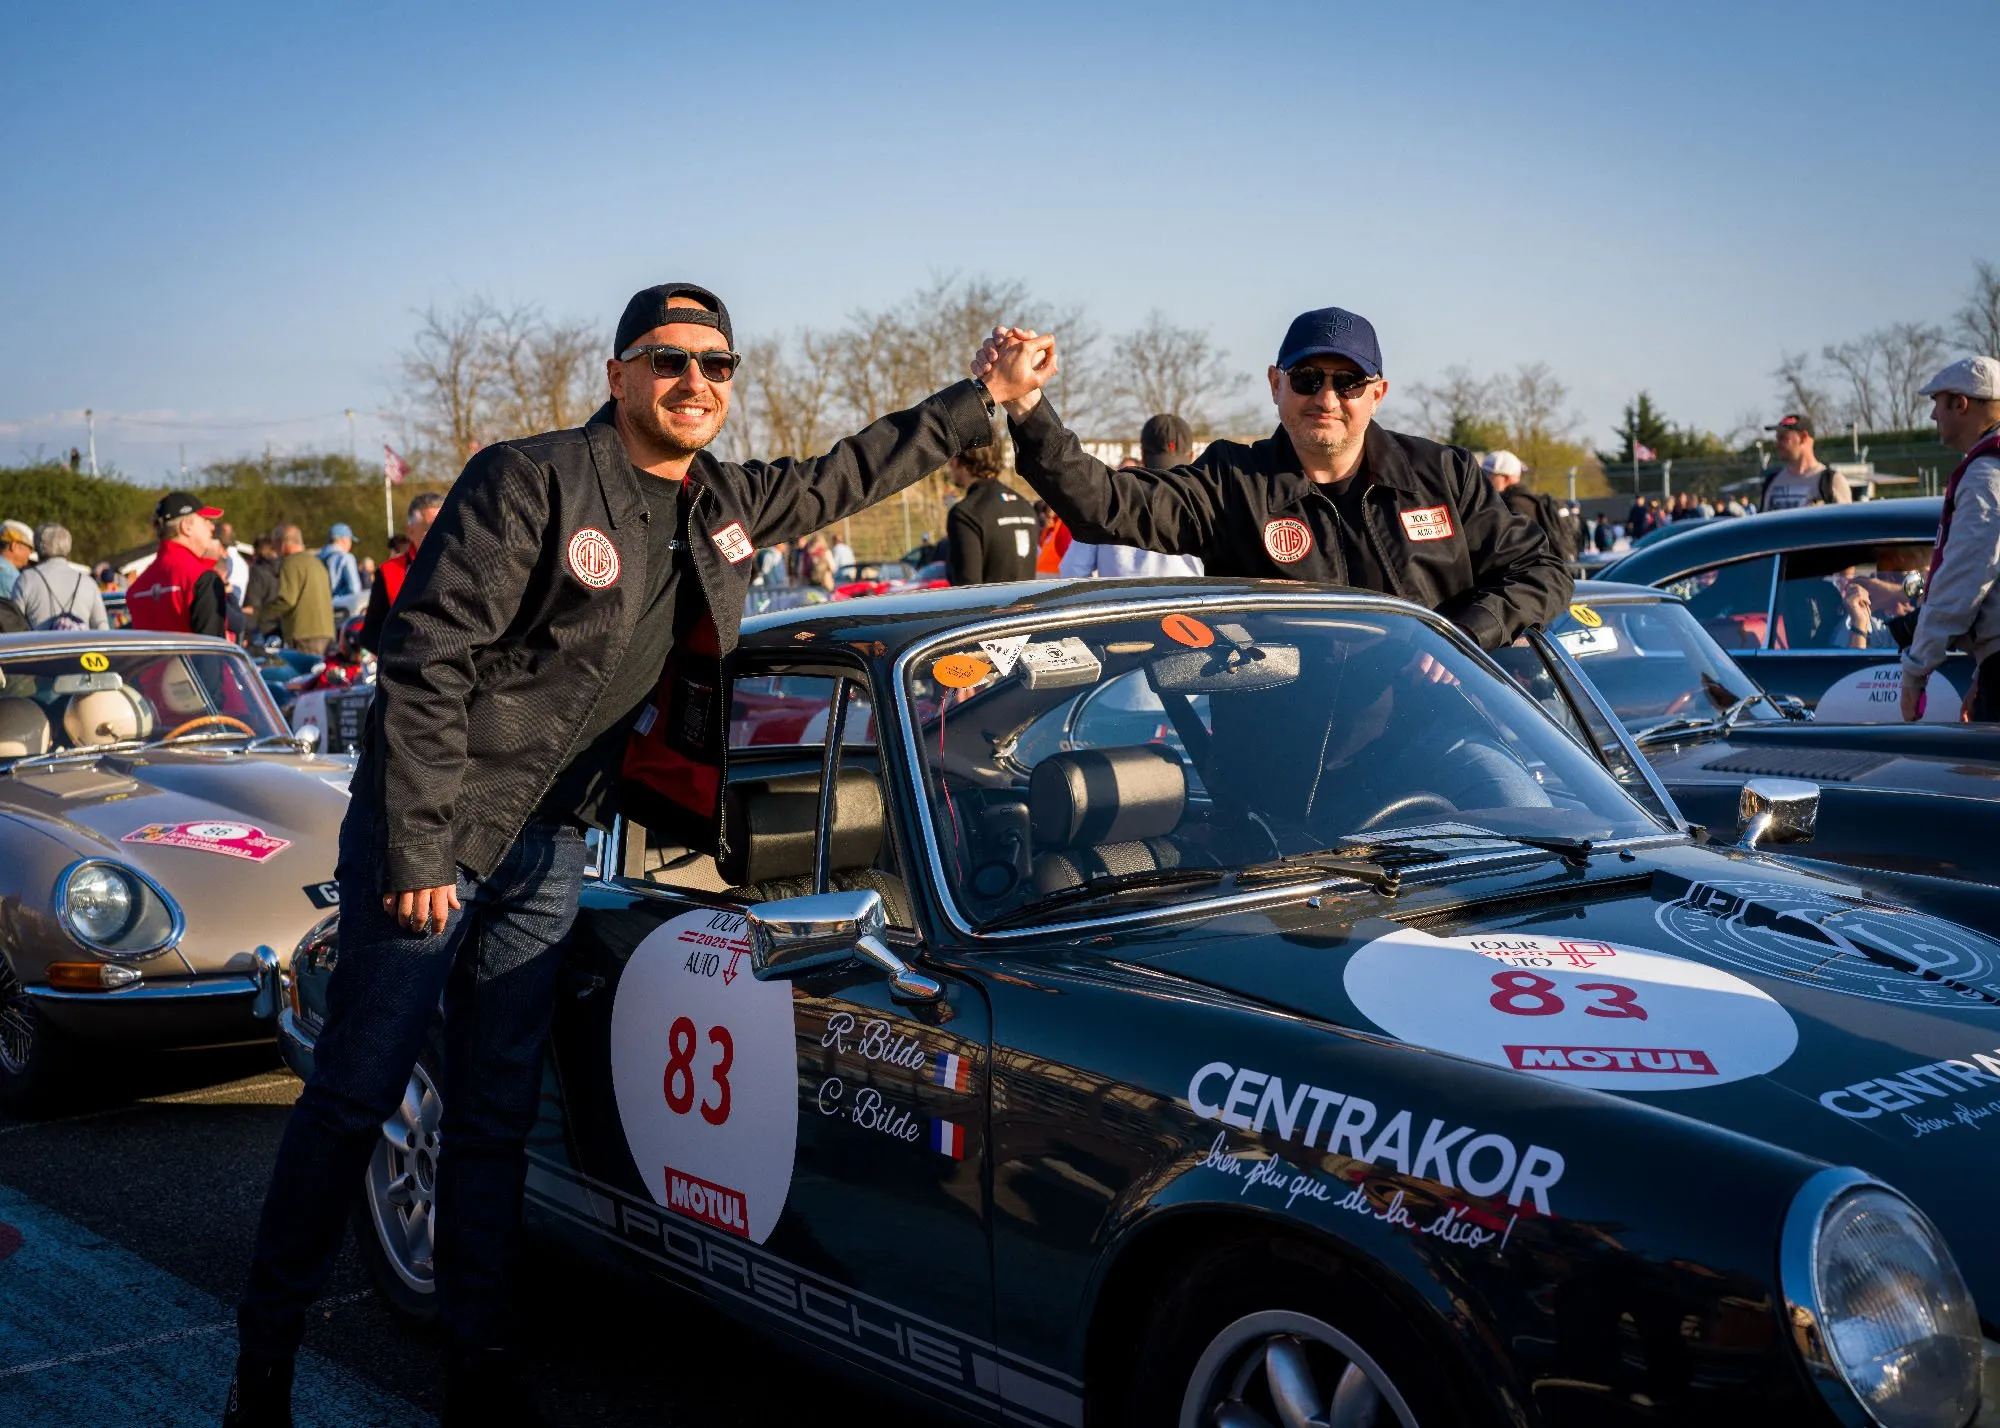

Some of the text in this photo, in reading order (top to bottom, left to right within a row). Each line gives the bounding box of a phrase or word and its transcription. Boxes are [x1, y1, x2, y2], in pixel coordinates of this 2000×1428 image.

[1285, 521, 1303, 530] AUTO
[576, 531, 611, 550] TOUR AUTO
[1272, 528, 1300, 553] DEUS
[580, 541, 609, 574] DEUS
[581, 574, 607, 586] FRANCE
[85, 656, 105, 668] M
[1873, 670, 1903, 681] TOUR
[1869, 690, 1898, 703] AUTO
[318, 882, 340, 904] G
[706, 912, 747, 934] TOUR
[695, 933, 730, 949] 2025
[684, 950, 720, 978] AUTO
[1497, 957, 1553, 967] UTO
[1489, 970, 1649, 1022] 83
[821, 1012, 926, 1071] R. Bilde
[663, 1016, 734, 1126] 83
[1521, 1048, 1705, 1071] MOTUL
[818, 1077, 920, 1142] C. Bilde
[1900, 1111, 1956, 1138] bien
[1187, 1061, 1565, 1217] CENTRAKOR
[1195, 1129, 1242, 1176] bien
[1240, 1153, 1289, 1196] plus
[1289, 1175, 1331, 1209] que
[1333, 1182, 1372, 1215] de
[1374, 1190, 1416, 1228] la
[1420, 1206, 1497, 1249] déco
[671, 1174, 745, 1230] MOTUL
[622, 1204, 964, 1381] PORSCHE
